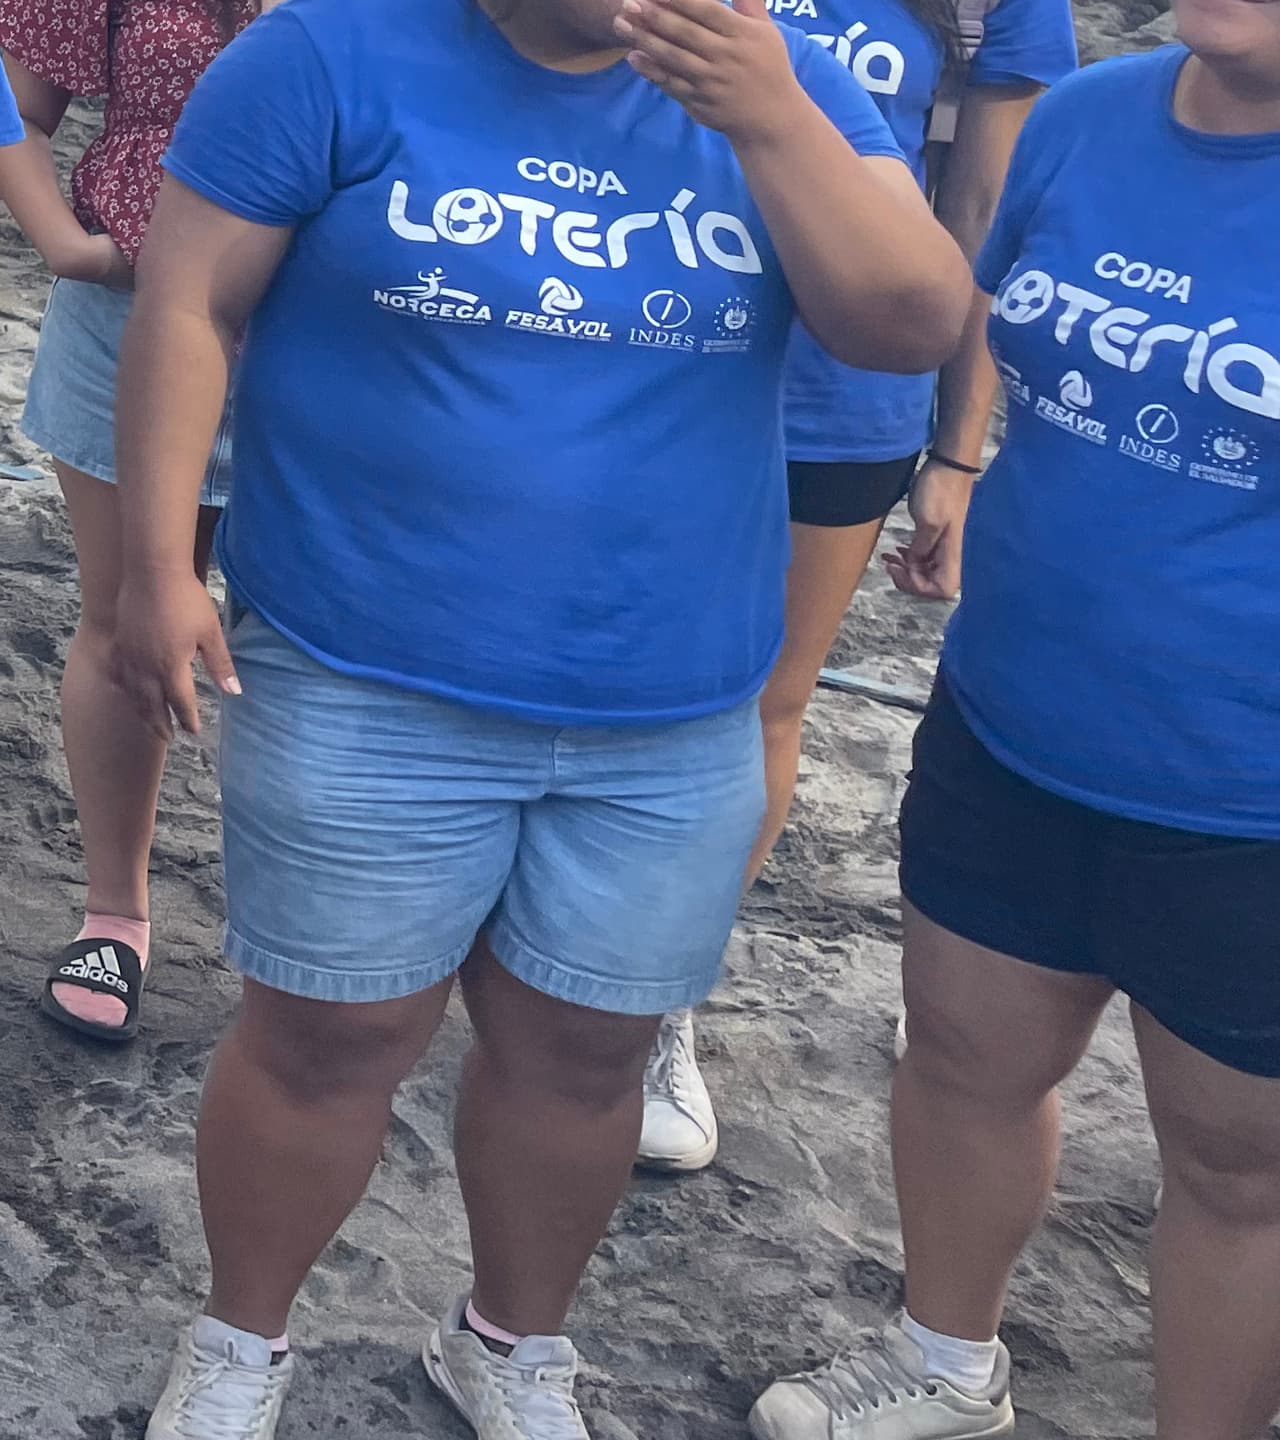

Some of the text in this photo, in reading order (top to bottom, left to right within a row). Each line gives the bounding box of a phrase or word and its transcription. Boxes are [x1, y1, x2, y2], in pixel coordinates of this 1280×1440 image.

[517, 156, 628, 197] COPA
[1094, 252, 1192, 304] COPA
[373, 289, 492, 321] NORCECA
[505, 310, 612, 338] FESAVOL
[629, 328, 696, 347] INDES
[1036, 395, 1107, 440] FESAVOL
[1119, 434, 1181, 469] INDES
[59, 964, 129, 993] adidas
